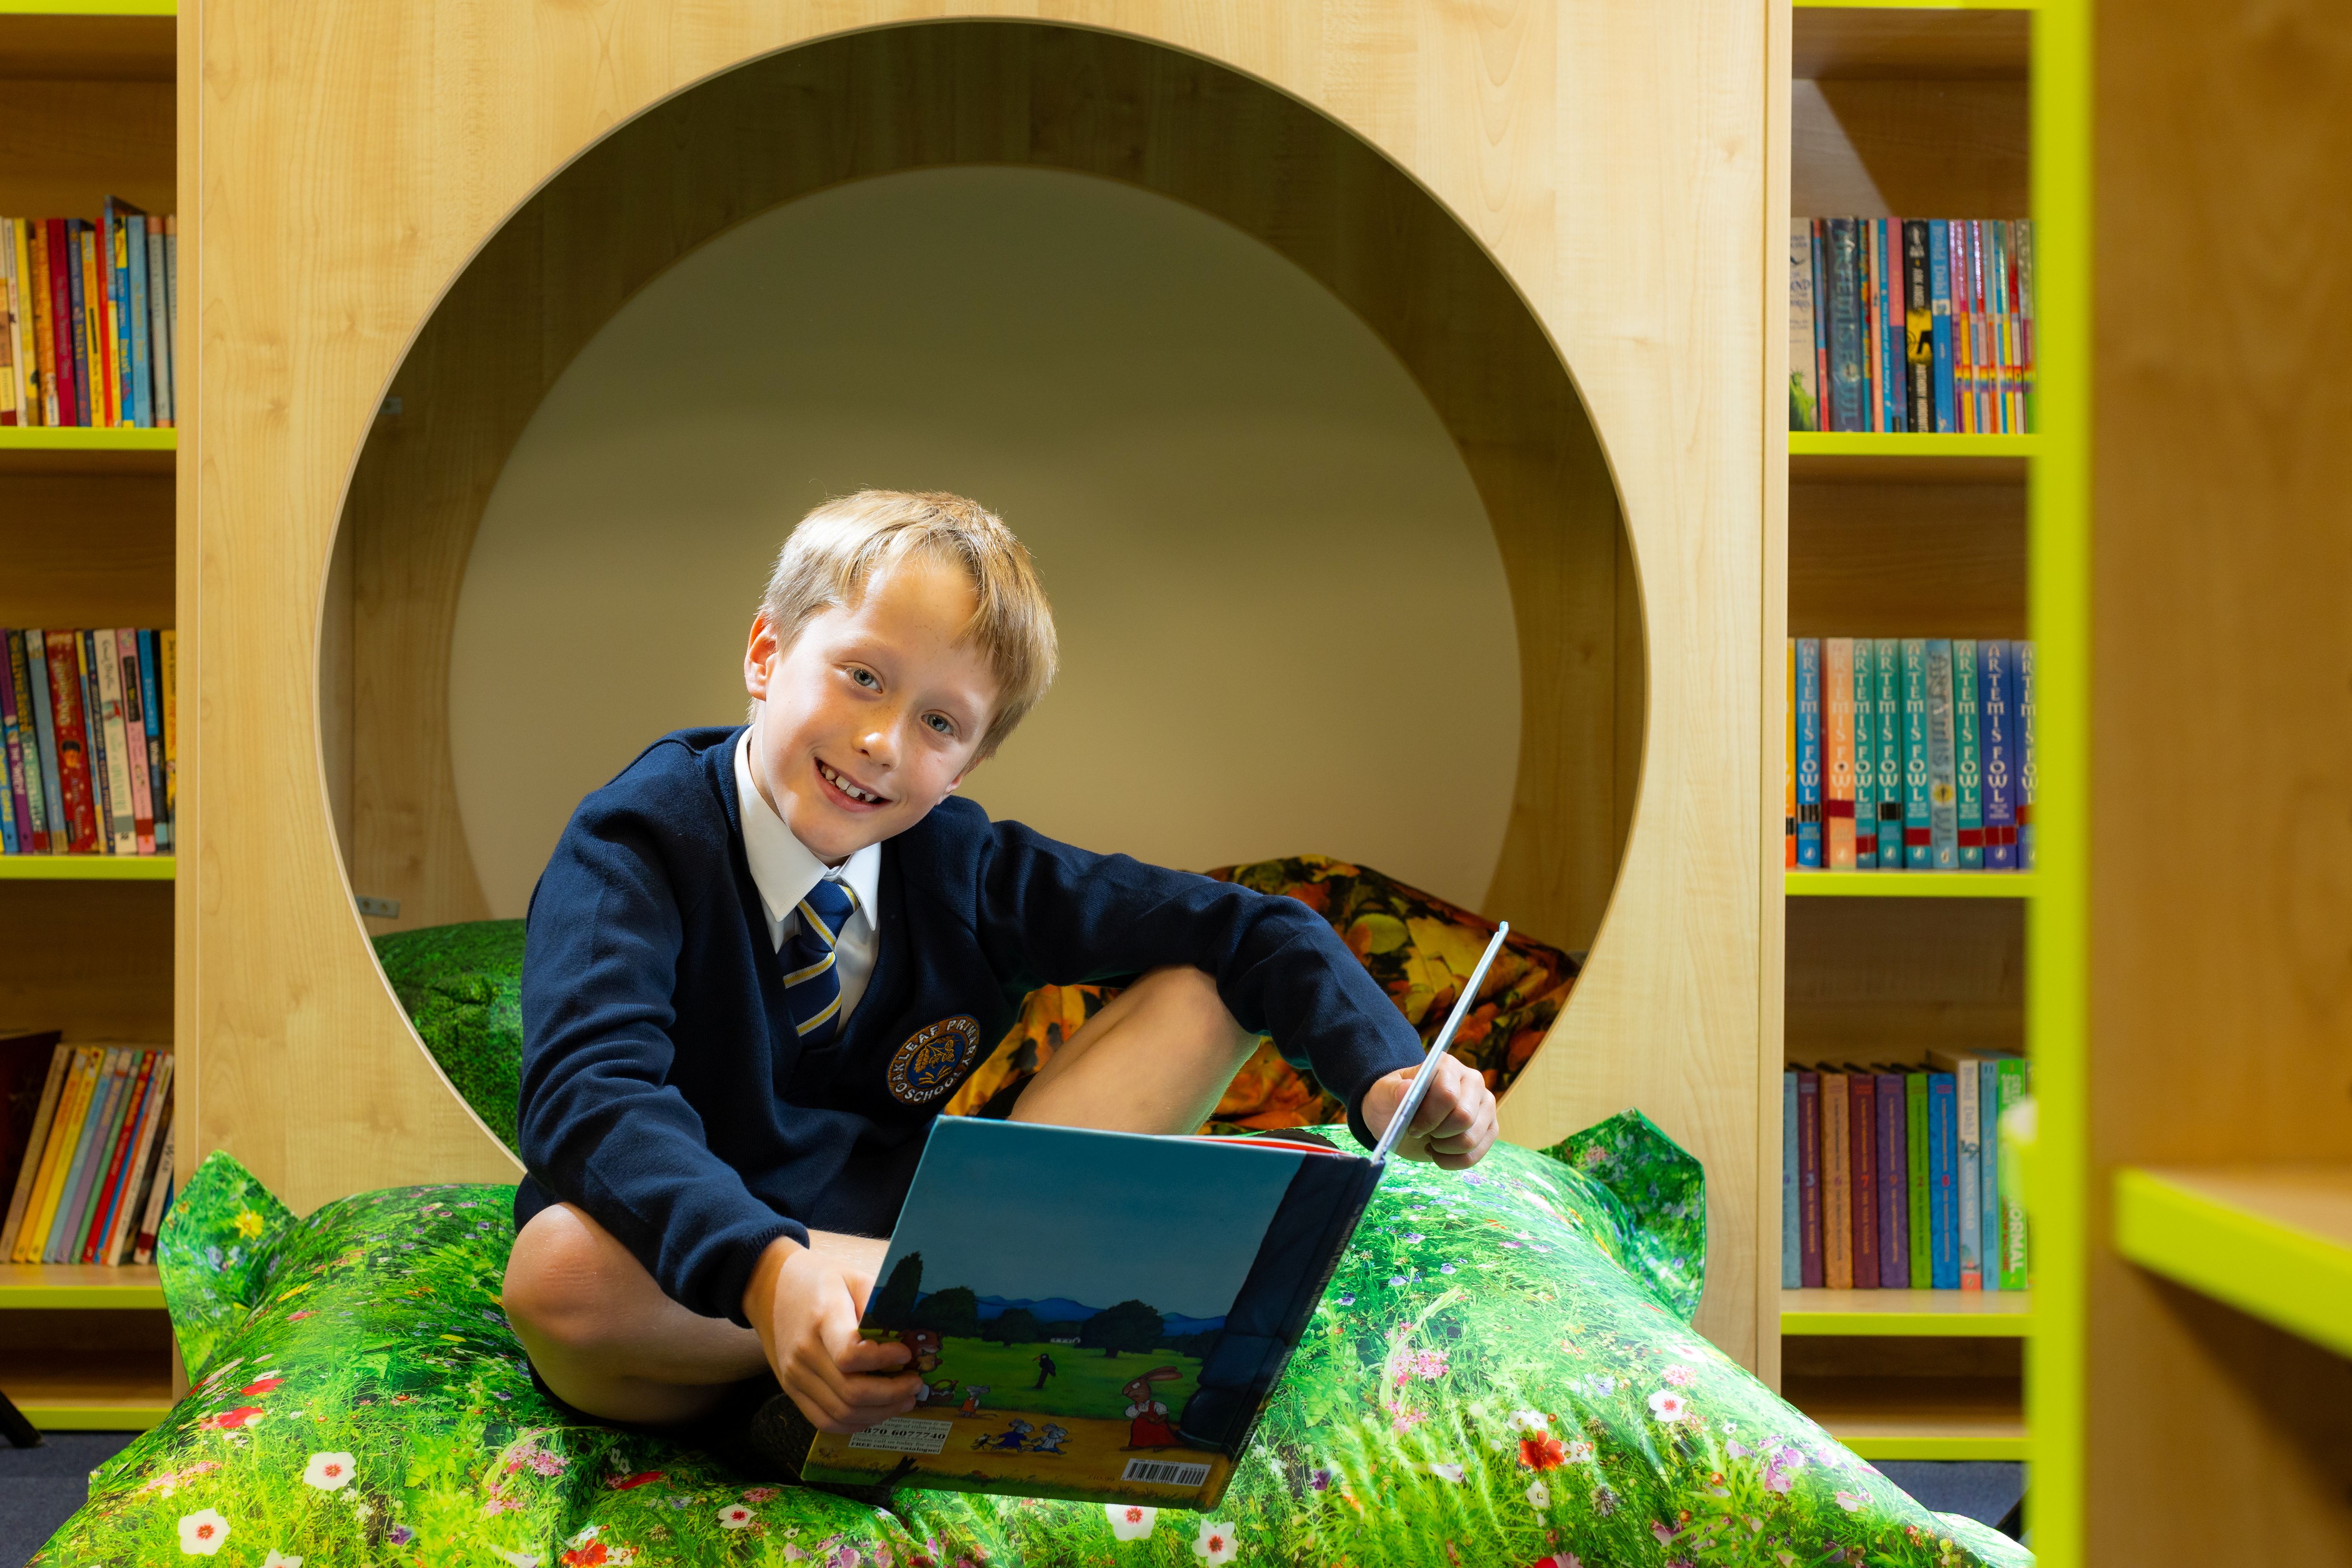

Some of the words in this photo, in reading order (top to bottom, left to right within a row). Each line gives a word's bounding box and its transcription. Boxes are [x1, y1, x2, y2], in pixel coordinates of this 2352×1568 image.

[1932, 226, 1945, 259] Roald
[1835, 230, 1857, 346] ARTEMIS
[1934, 266, 1947, 295] Dahl
[1836, 352, 1859, 425] FOWL
[1801, 641, 1817, 741] ARTEMIS
[1854, 642, 1870, 741] ARTEMIS
[1879, 642, 1896, 741] ARTEMIS
[1907, 642, 1923, 741] ARTEMIS
[1959, 644, 1975, 742] ARTEMIS
[1987, 644, 2004, 743] ARTEMIS
[2021, 646, 2037, 745] ARTEMIS
[1800, 745, 1819, 802] FOWL
[1854, 745, 1872, 802] FOWL
[1879, 745, 1898, 801] FOWL
[1907, 745, 1926, 801] FOWL
[1959, 746, 1978, 803] FOWL
[1988, 746, 2008, 803] FOWL
[892, 1024, 939, 1093] OAKLEAF
[947, 1019, 978, 1067] PRIMARY
[1963, 1067, 1974, 1101] Roald
[904, 1071, 963, 1103] SCHOOL
[1963, 1107, 1975, 1135] Dahl
[1861, 1175, 1869, 1187] 7
[891, 1430, 946, 1439] 6077740
